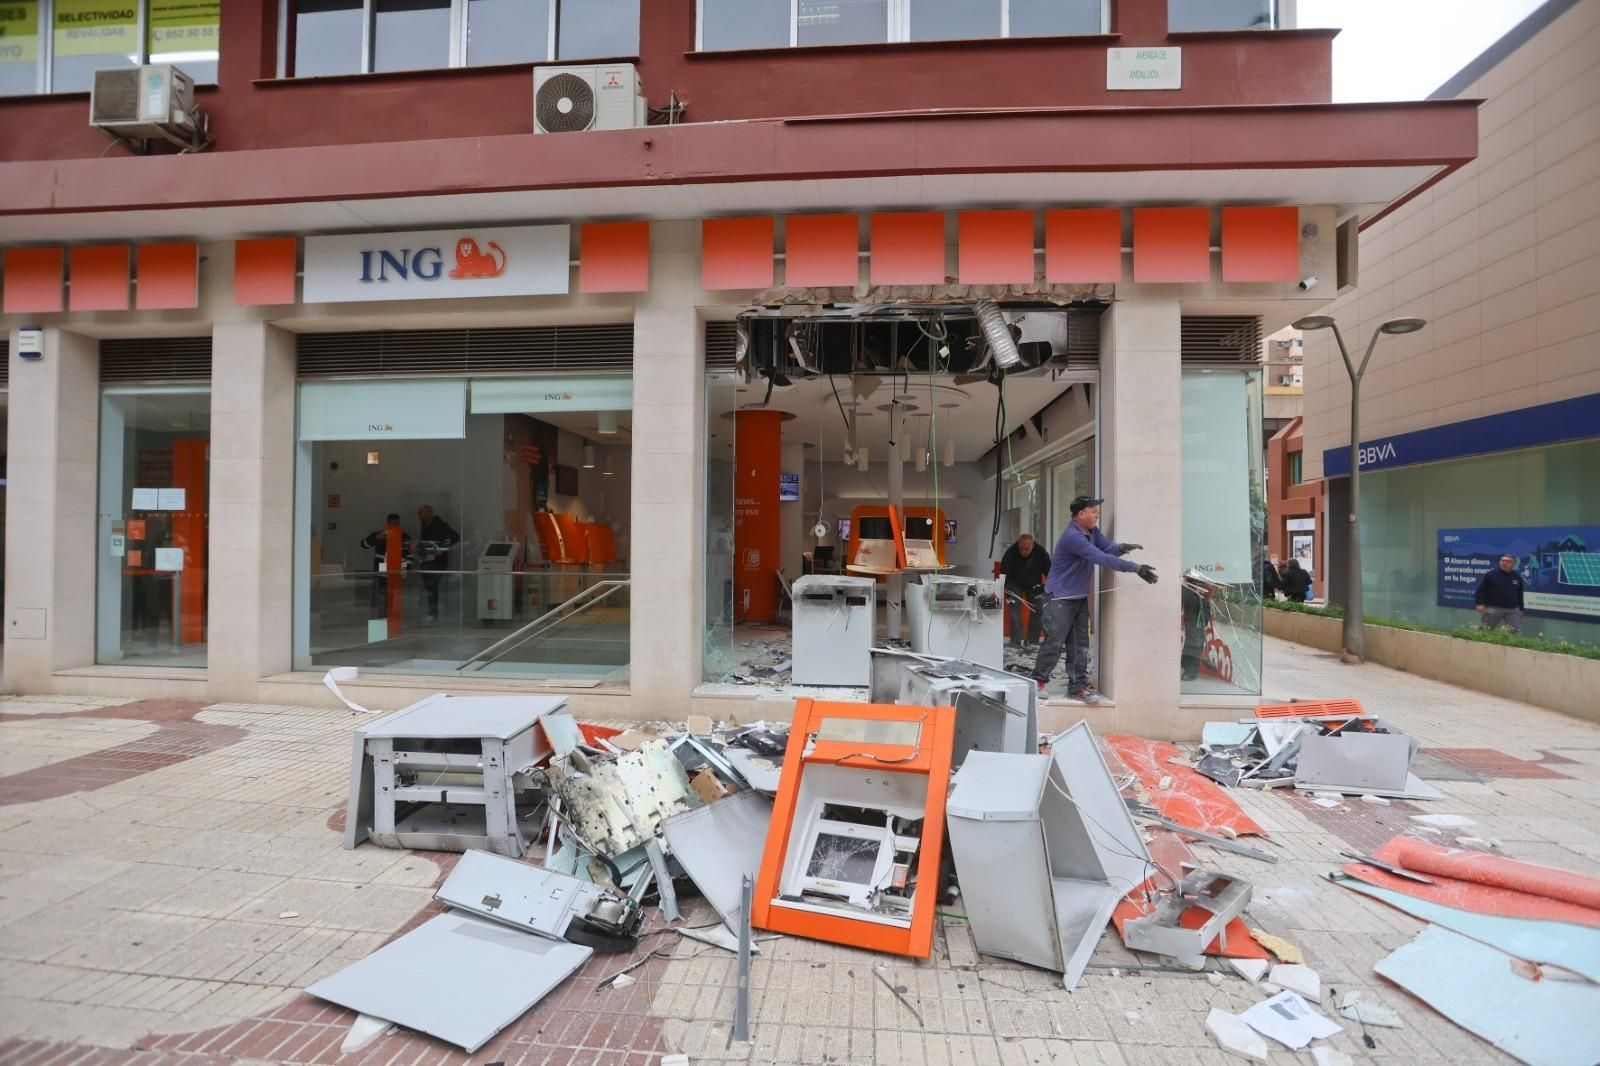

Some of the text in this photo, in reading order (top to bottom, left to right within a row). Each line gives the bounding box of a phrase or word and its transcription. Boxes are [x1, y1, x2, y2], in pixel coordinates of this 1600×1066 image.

[58, 9, 134, 22] SELECTIVIDAD
[165, 29, 185, 39] 952
[187, 28, 199, 37] 30
[201, 26, 214, 36] 35
[1136, 50, 1167, 60] AVENIDA DE
[359, 247, 443, 282] ING
[544, 392, 561, 401] ING
[1358, 441, 1397, 466] BBVA
[1444, 535, 1459, 543] BBVA
[1450, 557, 1490, 566] Ahorra dinero
[1195, 564, 1213, 572] ING
[1460, 575, 1476, 584] hogar
